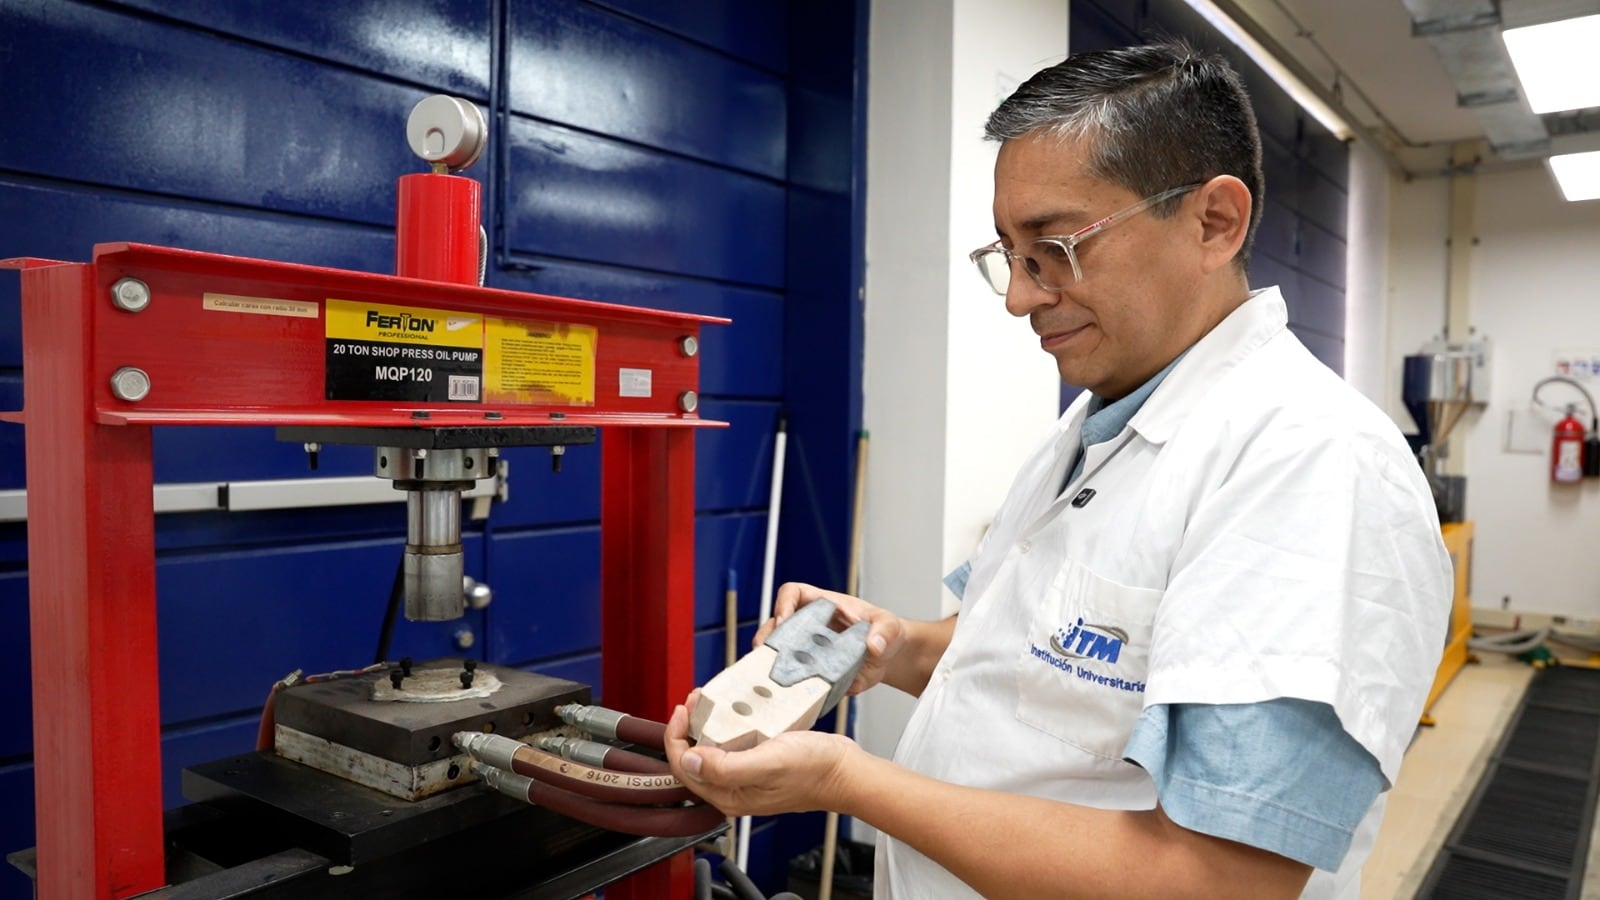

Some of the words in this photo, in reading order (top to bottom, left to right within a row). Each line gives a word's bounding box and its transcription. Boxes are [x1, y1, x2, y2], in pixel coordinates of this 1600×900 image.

[366, 310, 435, 332] FERTON
[378, 331, 428, 340] PROFESSIONAL
[333, 344, 346, 354] 20
[347, 345, 370, 356] TON
[371, 346, 400, 358] SHOP
[401, 348, 434, 360] PRESS
[435, 350, 451, 361] OIL
[452, 351, 479, 362] PUMP
[375, 366, 433, 382] MQP120
[1030, 643, 1073, 674] Institución
[586, 770, 620, 784] 2016
